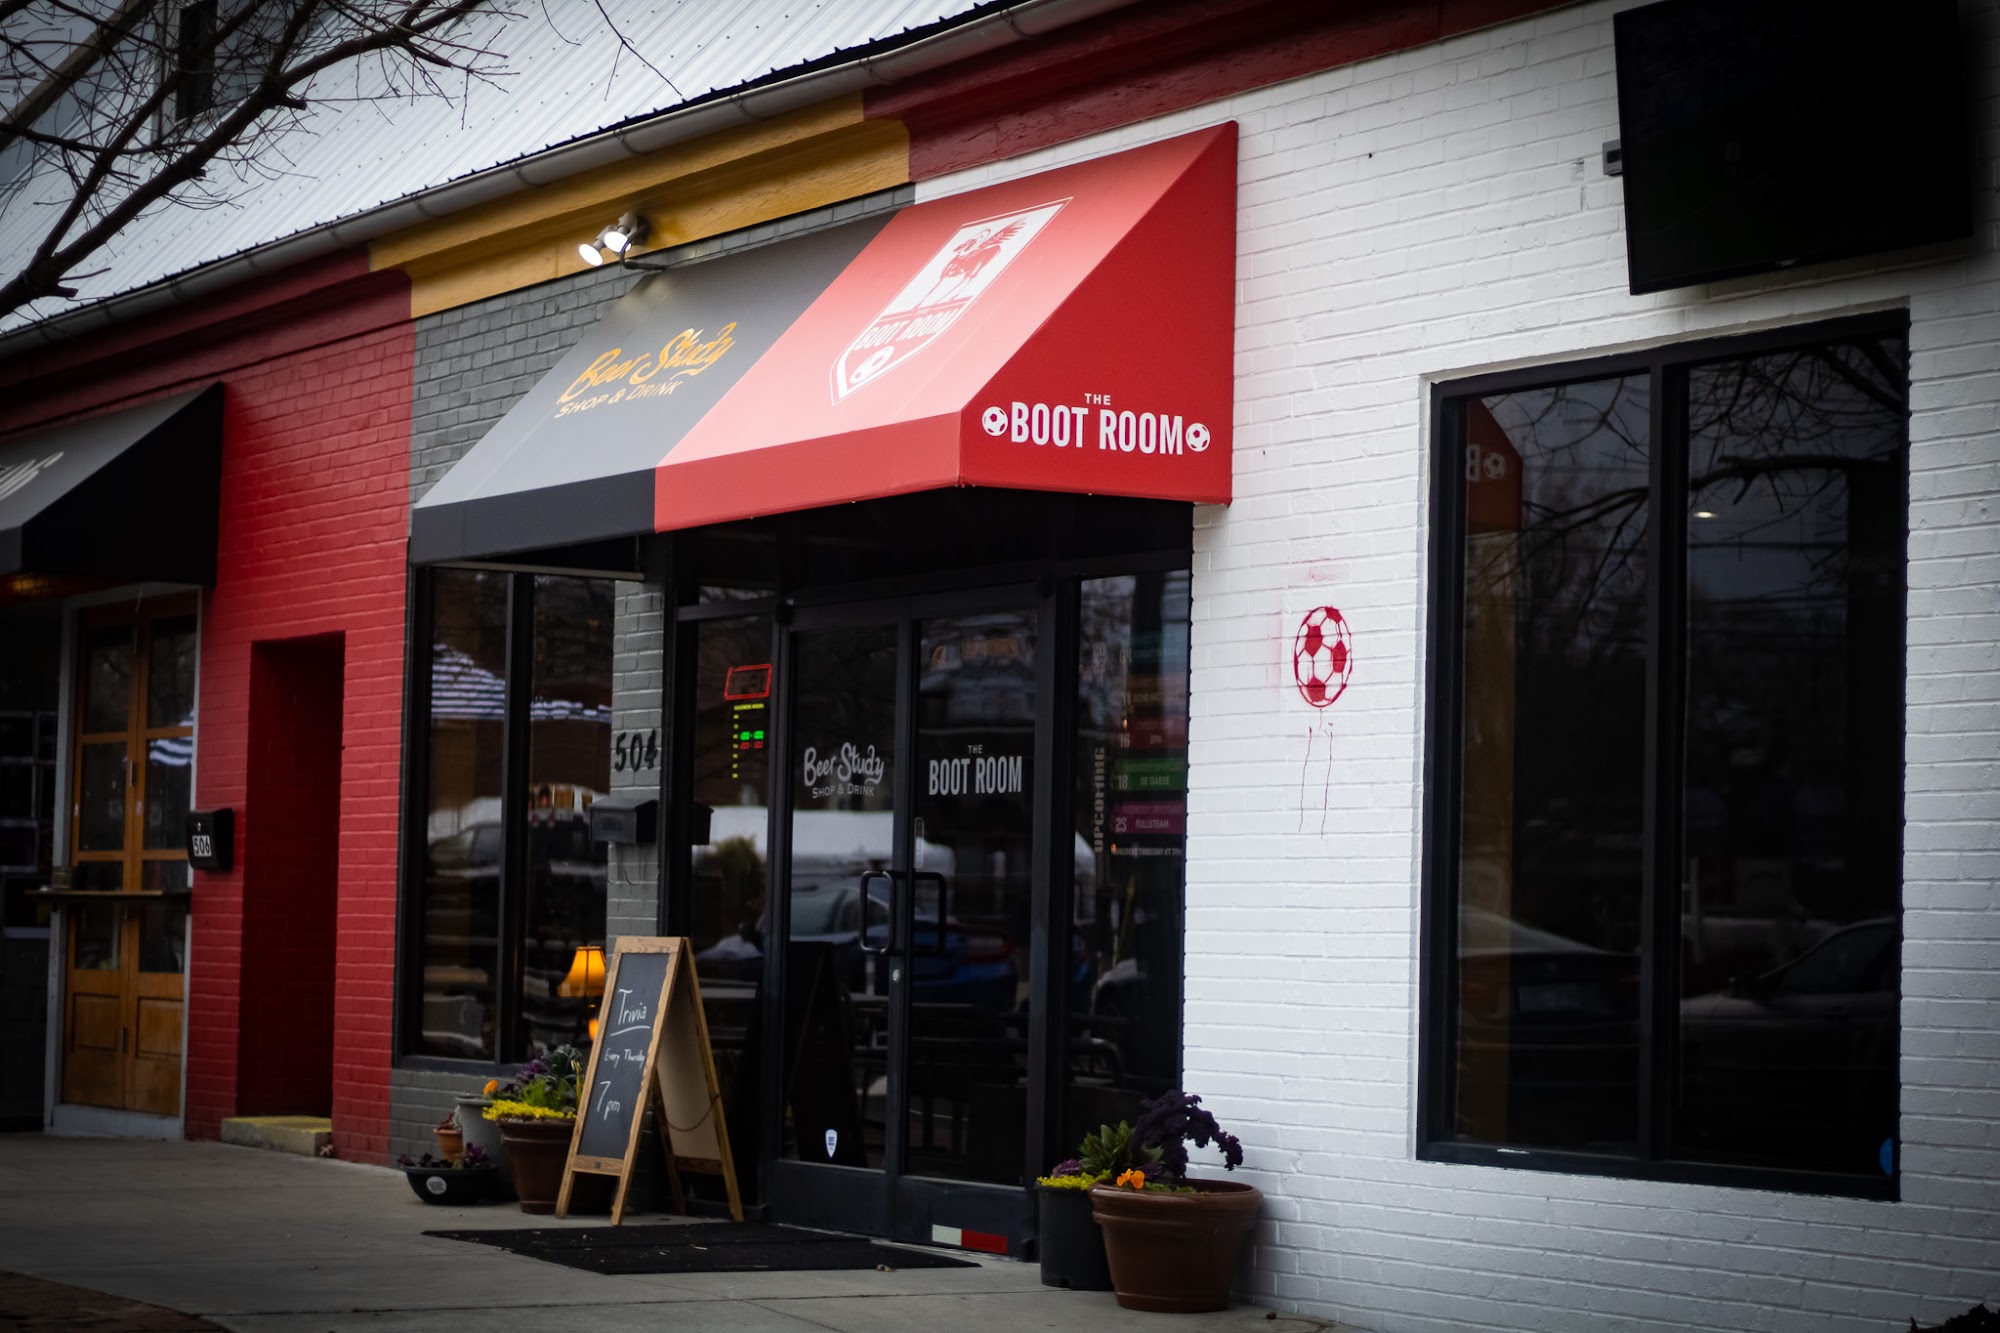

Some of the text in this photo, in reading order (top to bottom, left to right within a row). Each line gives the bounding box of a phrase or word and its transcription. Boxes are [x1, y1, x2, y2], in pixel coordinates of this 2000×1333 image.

[852, 309, 959, 351] BOOT ROOM
[556, 321, 737, 404] Beer Study
[554, 381, 683, 418] SHOP & DRINK
[1084, 393, 1111, 406] THE
[1010, 401, 1183, 455] BOOT ROOM
[614, 728, 658, 772] 504
[804, 742, 884, 786] Beer Study
[968, 745, 983, 755] THE
[812, 783, 876, 799] SHOP & DRINK
[928, 755, 1023, 796] BOOT ROOM
[1117, 774, 1128, 790] 18
[1093, 747, 1105, 853] UPCOMING
[1115, 816, 1127, 832] 25
[194, 837, 210, 854] 506
[618, 989, 648, 1025] Trivia
[597, 1081, 621, 1120] 7 pm
